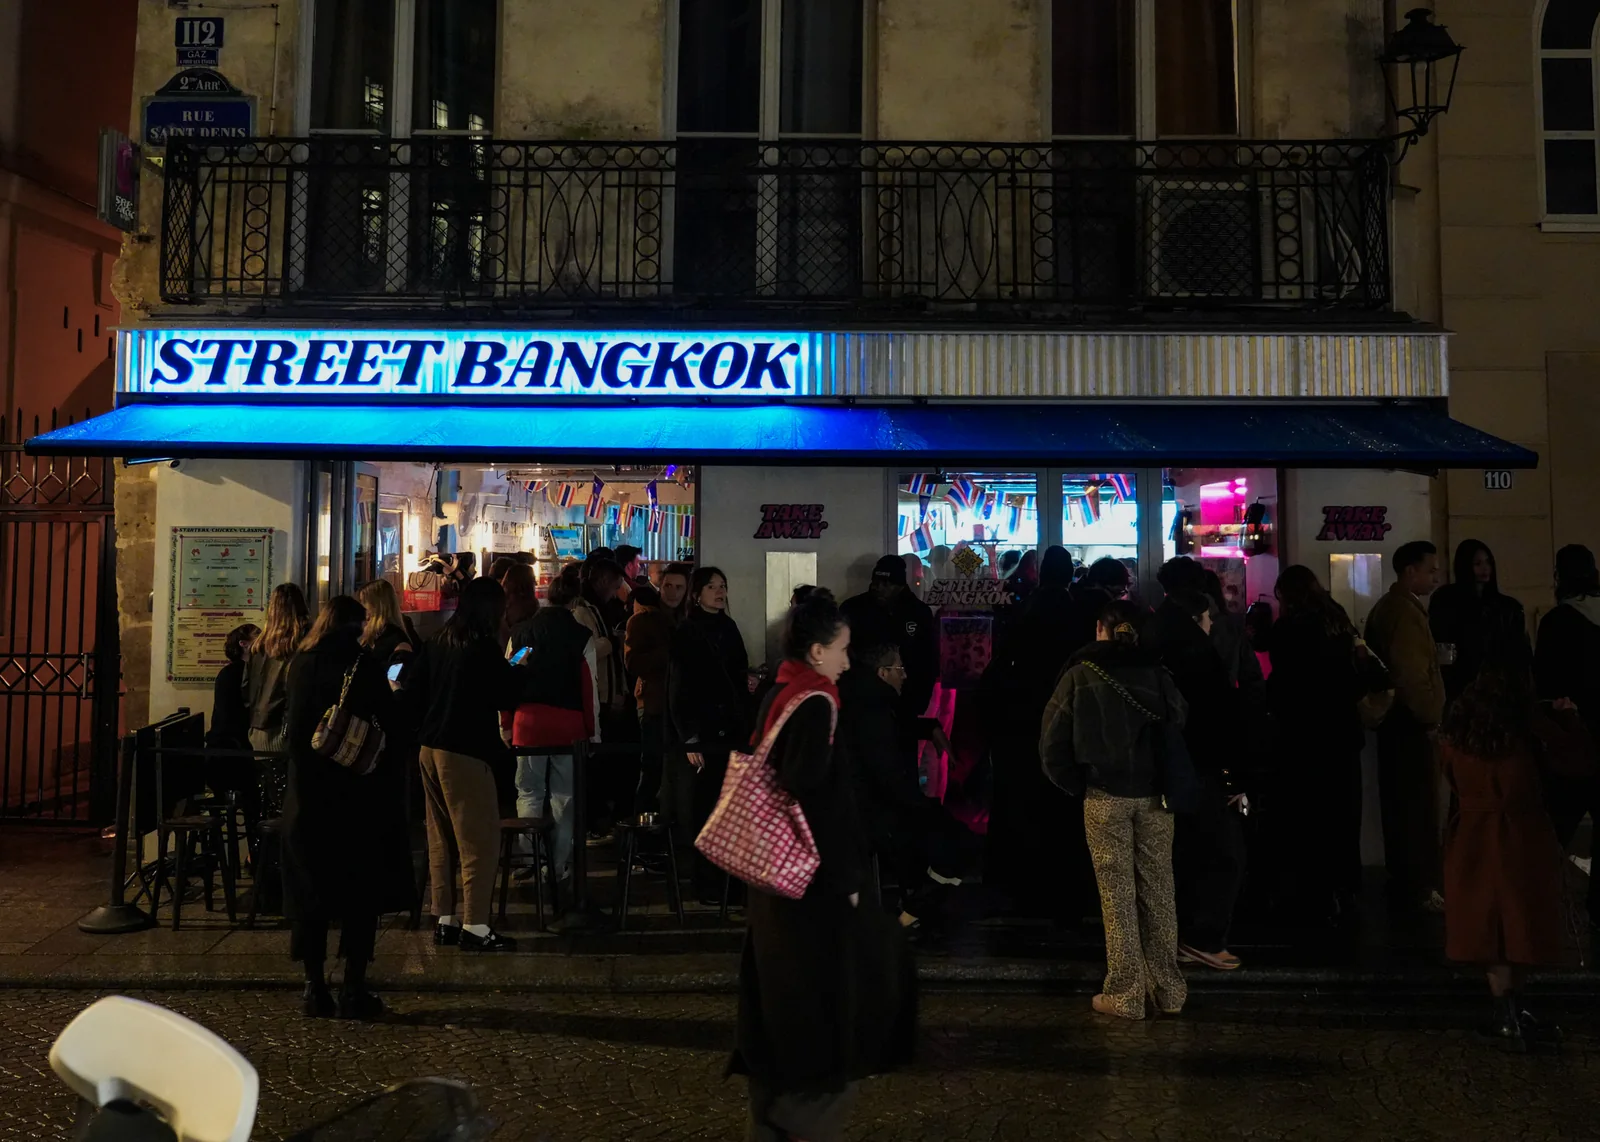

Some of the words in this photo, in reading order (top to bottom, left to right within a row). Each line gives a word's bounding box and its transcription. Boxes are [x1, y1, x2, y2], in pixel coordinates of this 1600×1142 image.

[182, 20, 216, 45] 112
[187, 50, 207, 58] GAZ
[182, 110, 215, 122] RUE
[150, 126, 195, 139] SAINT
[200, 127, 246, 138] DENIS
[150, 338, 445, 386] STREET
[451, 340, 801, 389] BANGKOK
[1485, 471, 1511, 489] 110
[760, 504, 824, 521] TAKE
[1322, 506, 1387, 523] TAKE
[753, 520, 829, 539] AWAY
[1316, 522, 1392, 541] AWAY
[933, 579, 1011, 592] STREET
[925, 591, 1016, 605] BANGKOK
